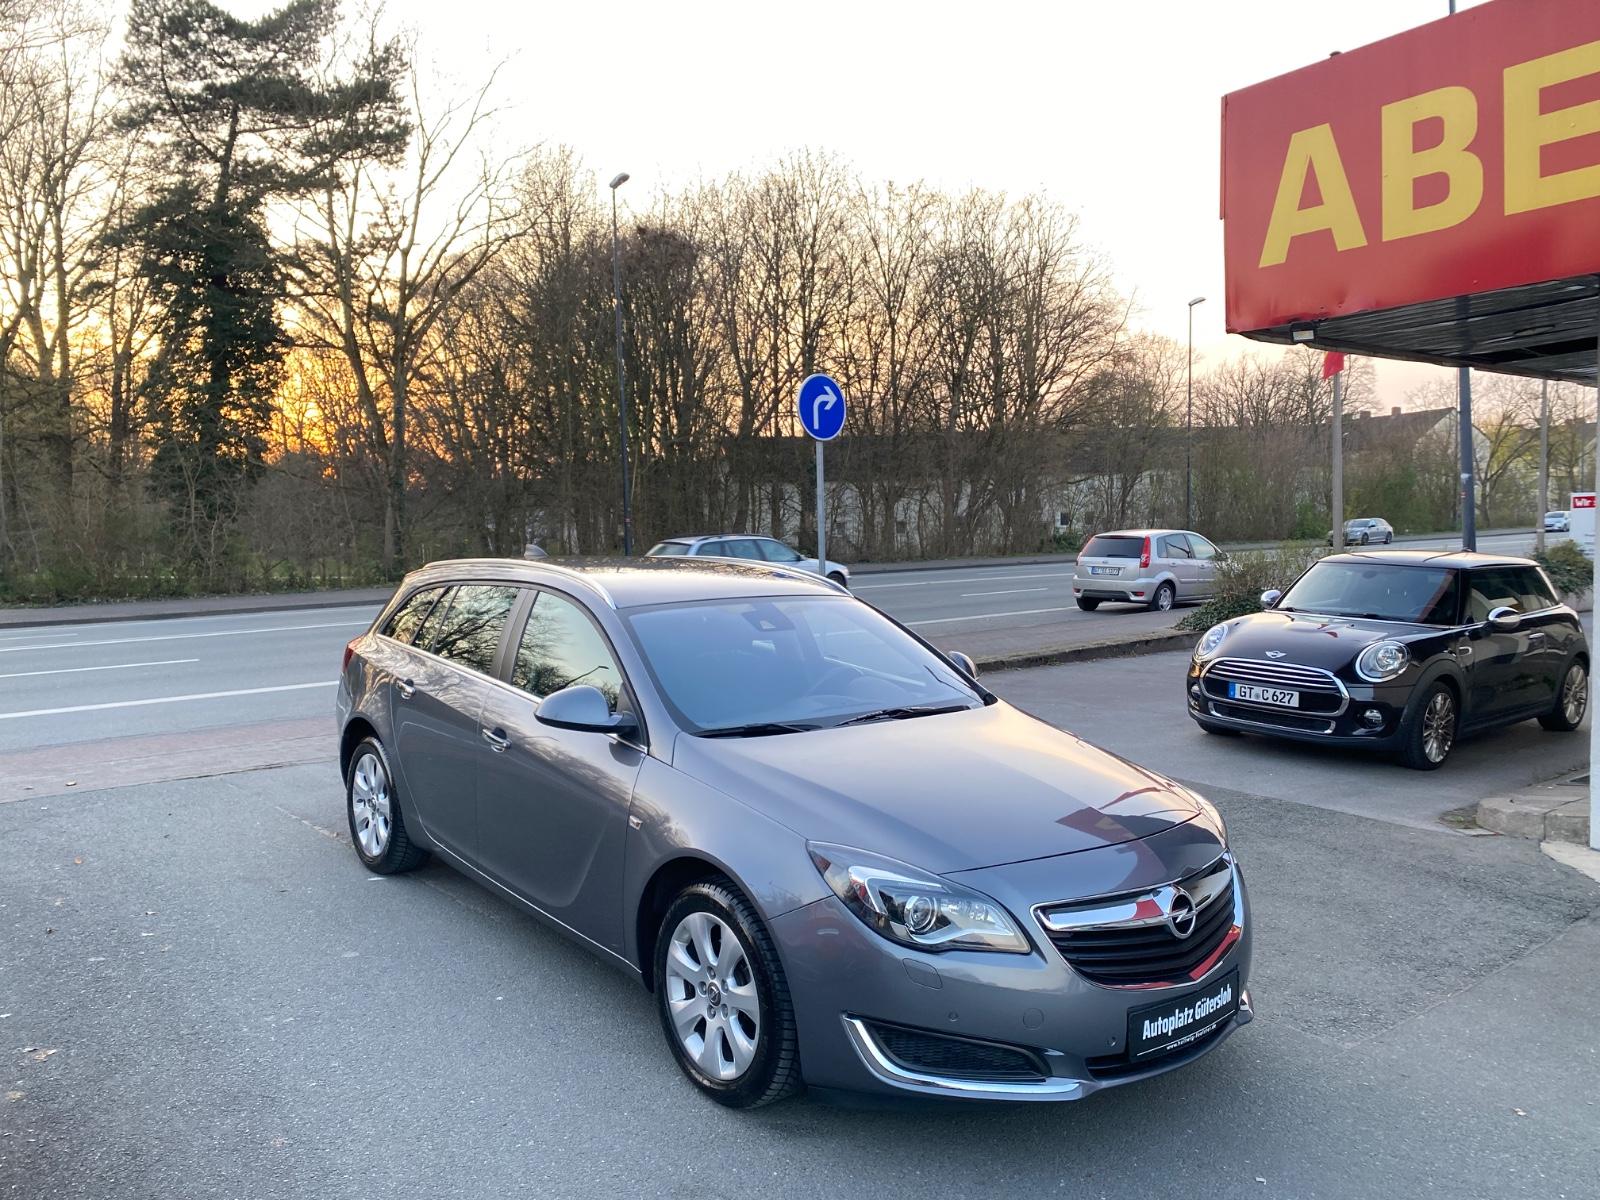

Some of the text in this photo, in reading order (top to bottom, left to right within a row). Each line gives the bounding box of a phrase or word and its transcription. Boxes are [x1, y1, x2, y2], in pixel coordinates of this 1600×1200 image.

[1259, 40, 1600, 268] ABE
[1239, 685, 1294, 705] GT C 627
[1142, 983, 1232, 1040] Autoplatz Gütersloh
